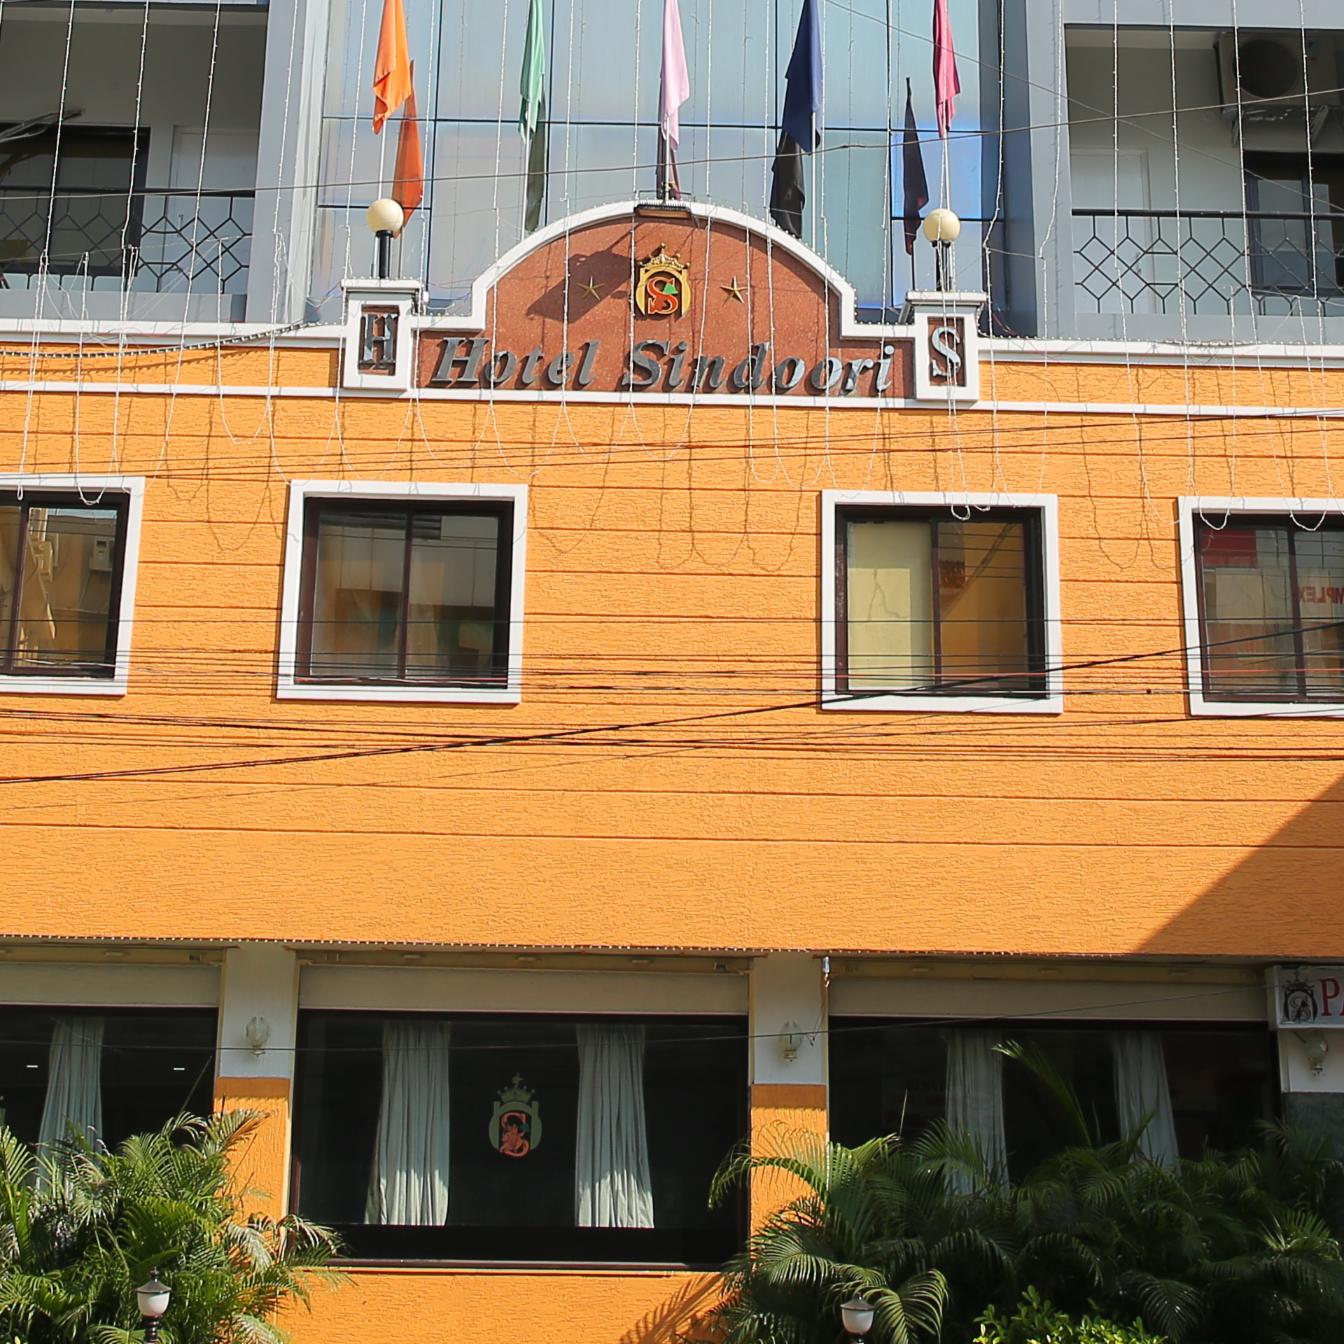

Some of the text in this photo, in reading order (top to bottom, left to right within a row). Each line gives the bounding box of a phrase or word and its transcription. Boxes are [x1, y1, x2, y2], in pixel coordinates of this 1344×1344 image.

[358, 313, 399, 370] H
[431, 336, 895, 393] Hotel Sindoori
[931, 326, 962, 378] S
